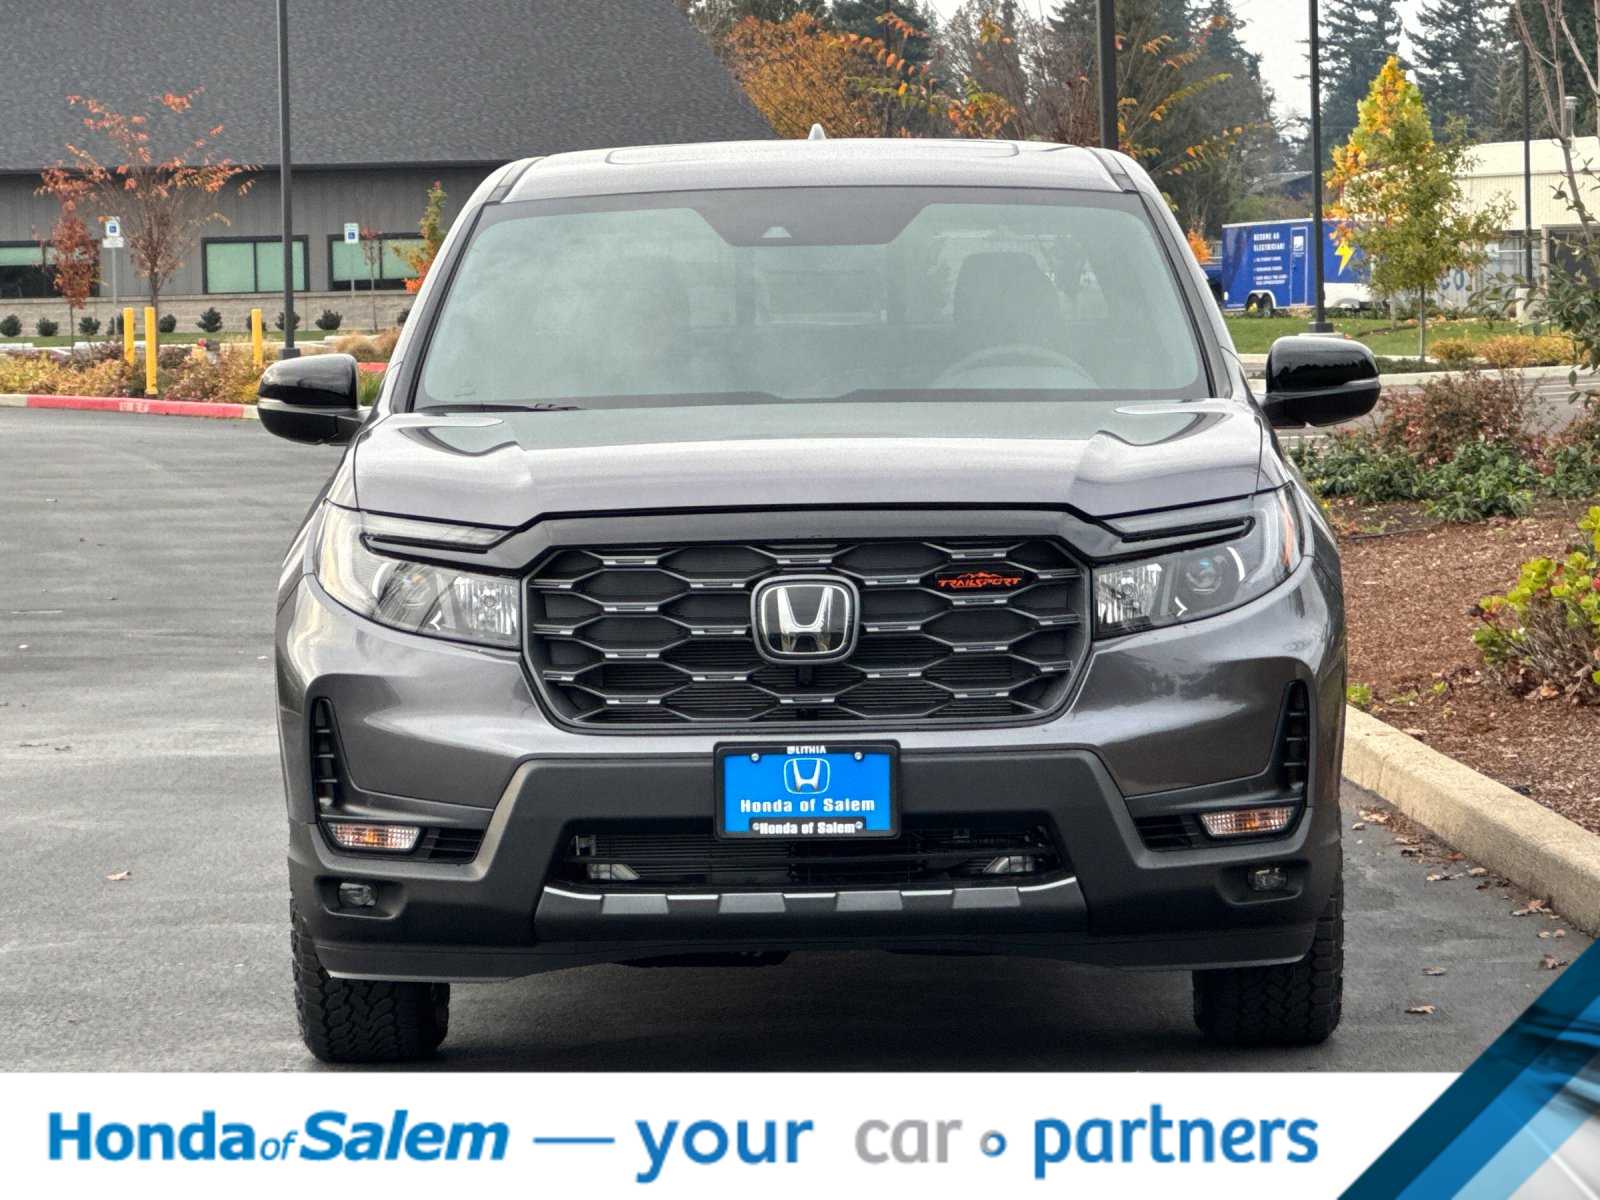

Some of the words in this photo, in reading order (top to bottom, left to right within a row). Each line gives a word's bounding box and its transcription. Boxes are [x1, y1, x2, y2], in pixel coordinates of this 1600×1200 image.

[938, 577, 1022, 589] TRAILSPORT
[796, 746, 827, 754] LITHIA
[740, 799, 793, 813] Honda
[799, 798, 816, 812] of
[823, 797, 876, 812] Salem
[759, 822, 798, 835] Honda
[801, 821, 814, 834] of
[817, 820, 856, 834] Salem
